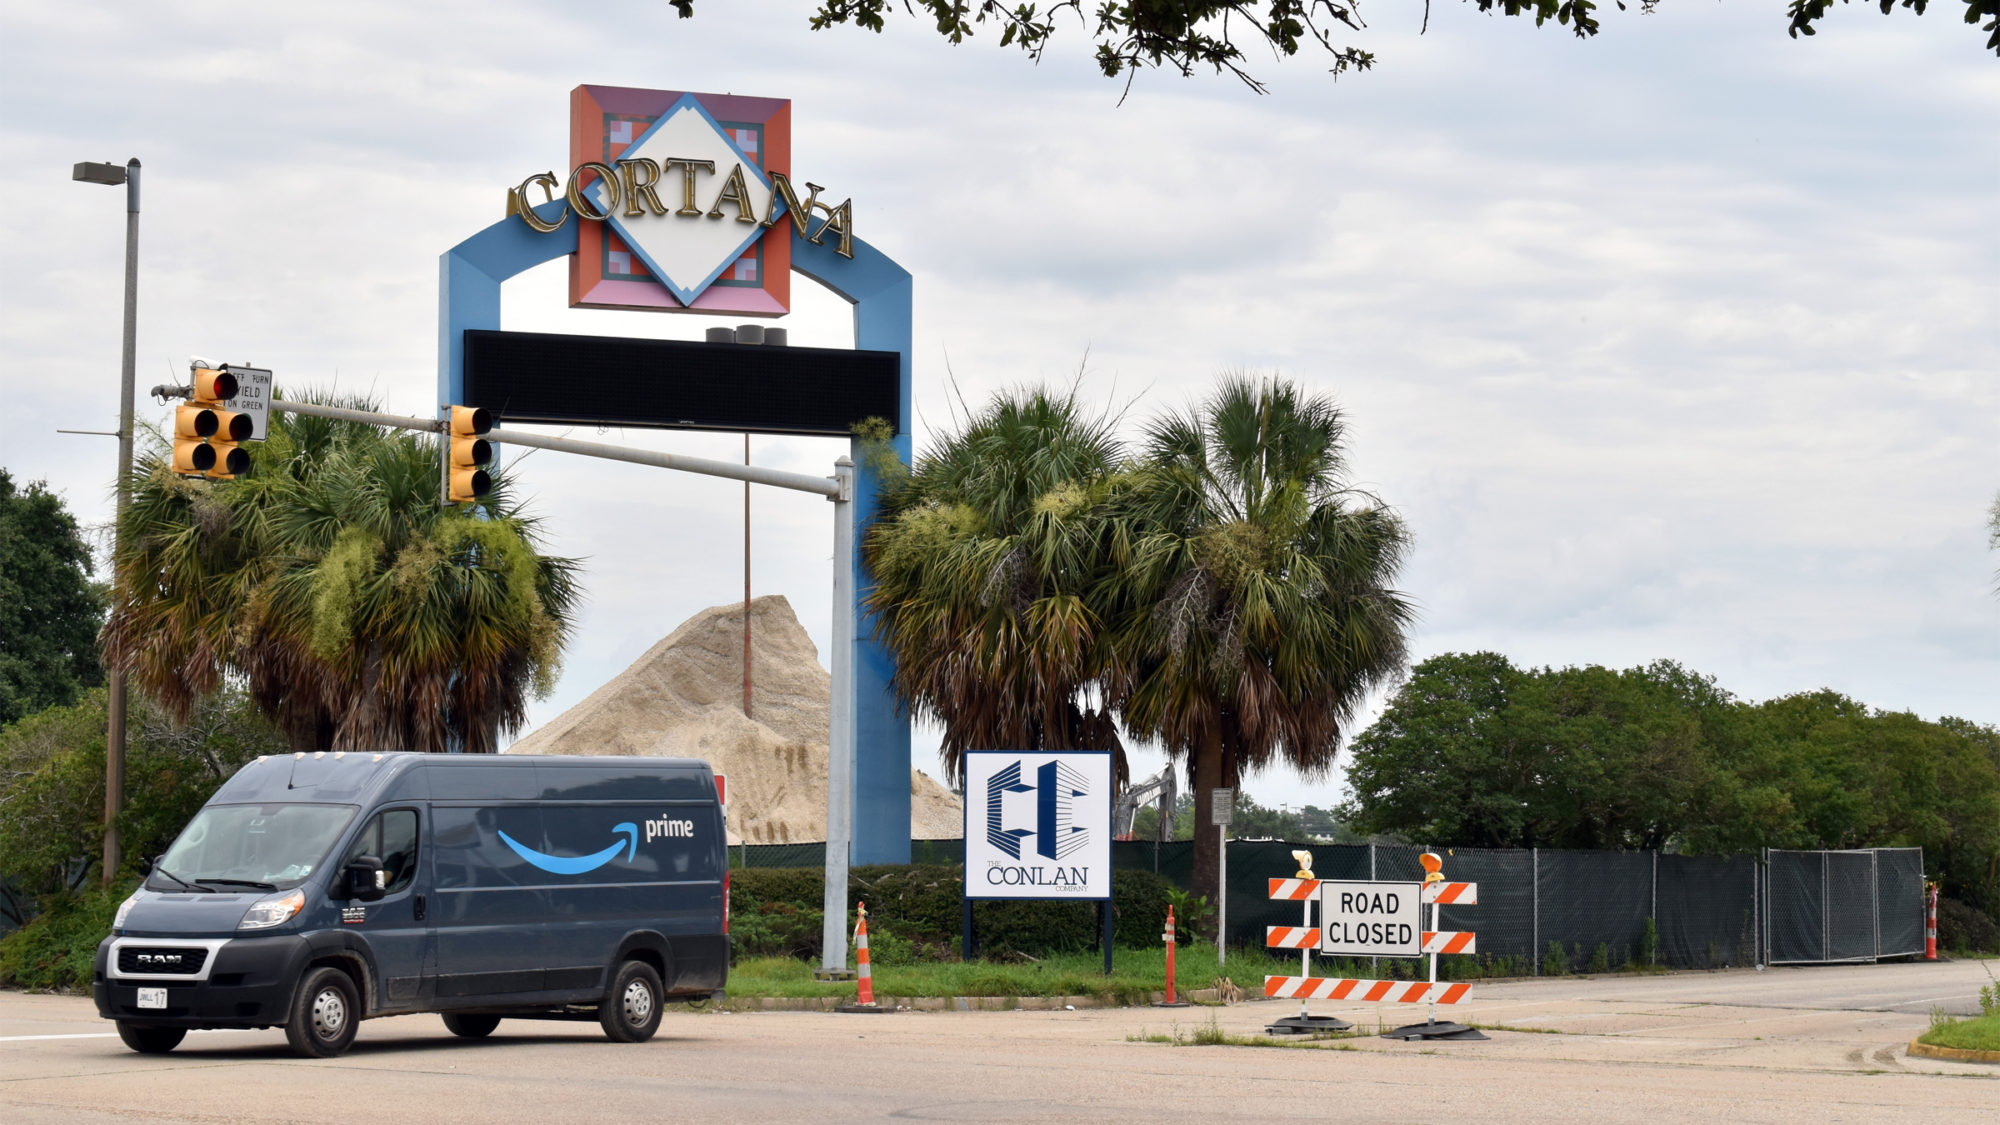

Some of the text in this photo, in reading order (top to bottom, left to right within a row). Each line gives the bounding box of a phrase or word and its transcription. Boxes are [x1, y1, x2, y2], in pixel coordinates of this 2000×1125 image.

[518, 157, 854, 260] CORTANA
[252, 374, 270, 385] TURN
[227, 399, 263, 410] ON GREEN
[645, 813, 694, 843] prime
[987, 866, 1089, 885] CONLAN
[1341, 892, 1399, 914] ROAD
[1329, 922, 1412, 945] CLOSED
[137, 954, 182, 965] RAM
